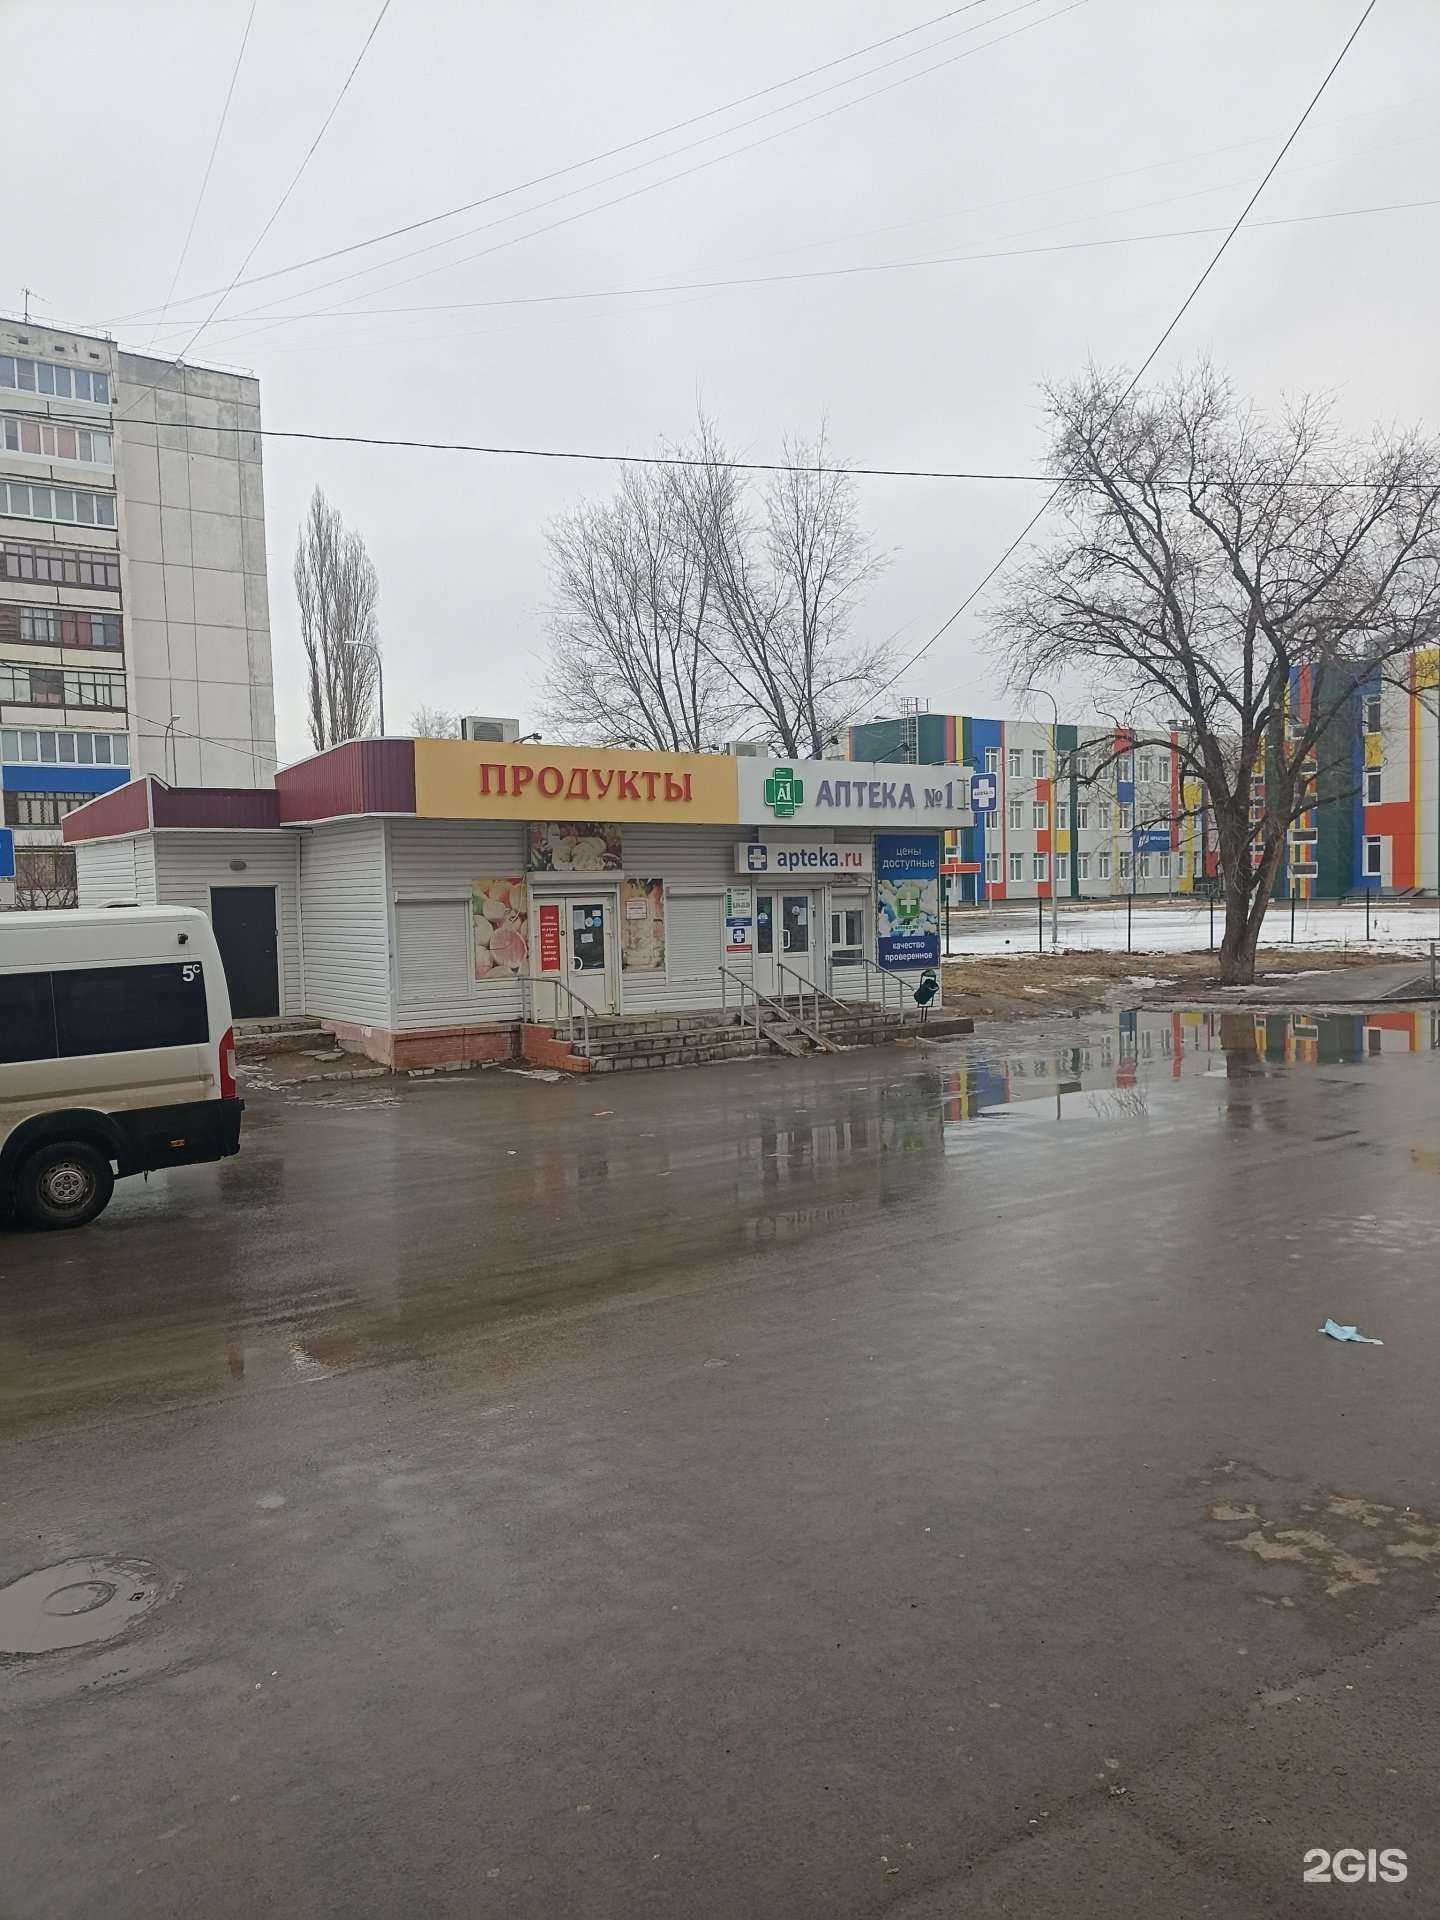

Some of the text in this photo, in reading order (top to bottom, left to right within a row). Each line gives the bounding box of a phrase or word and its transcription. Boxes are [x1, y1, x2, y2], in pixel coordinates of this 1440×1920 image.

[479, 763, 693, 801] ПРОДУКТЫ
[815, 780, 954, 809] АПТЕКА №1
[896, 847, 922, 857] цены
[777, 846, 863, 872] apteka.ru
[882, 859, 935, 871] доступные
[892, 941, 925, 950] качество
[885, 952, 933, 963] проверенное
